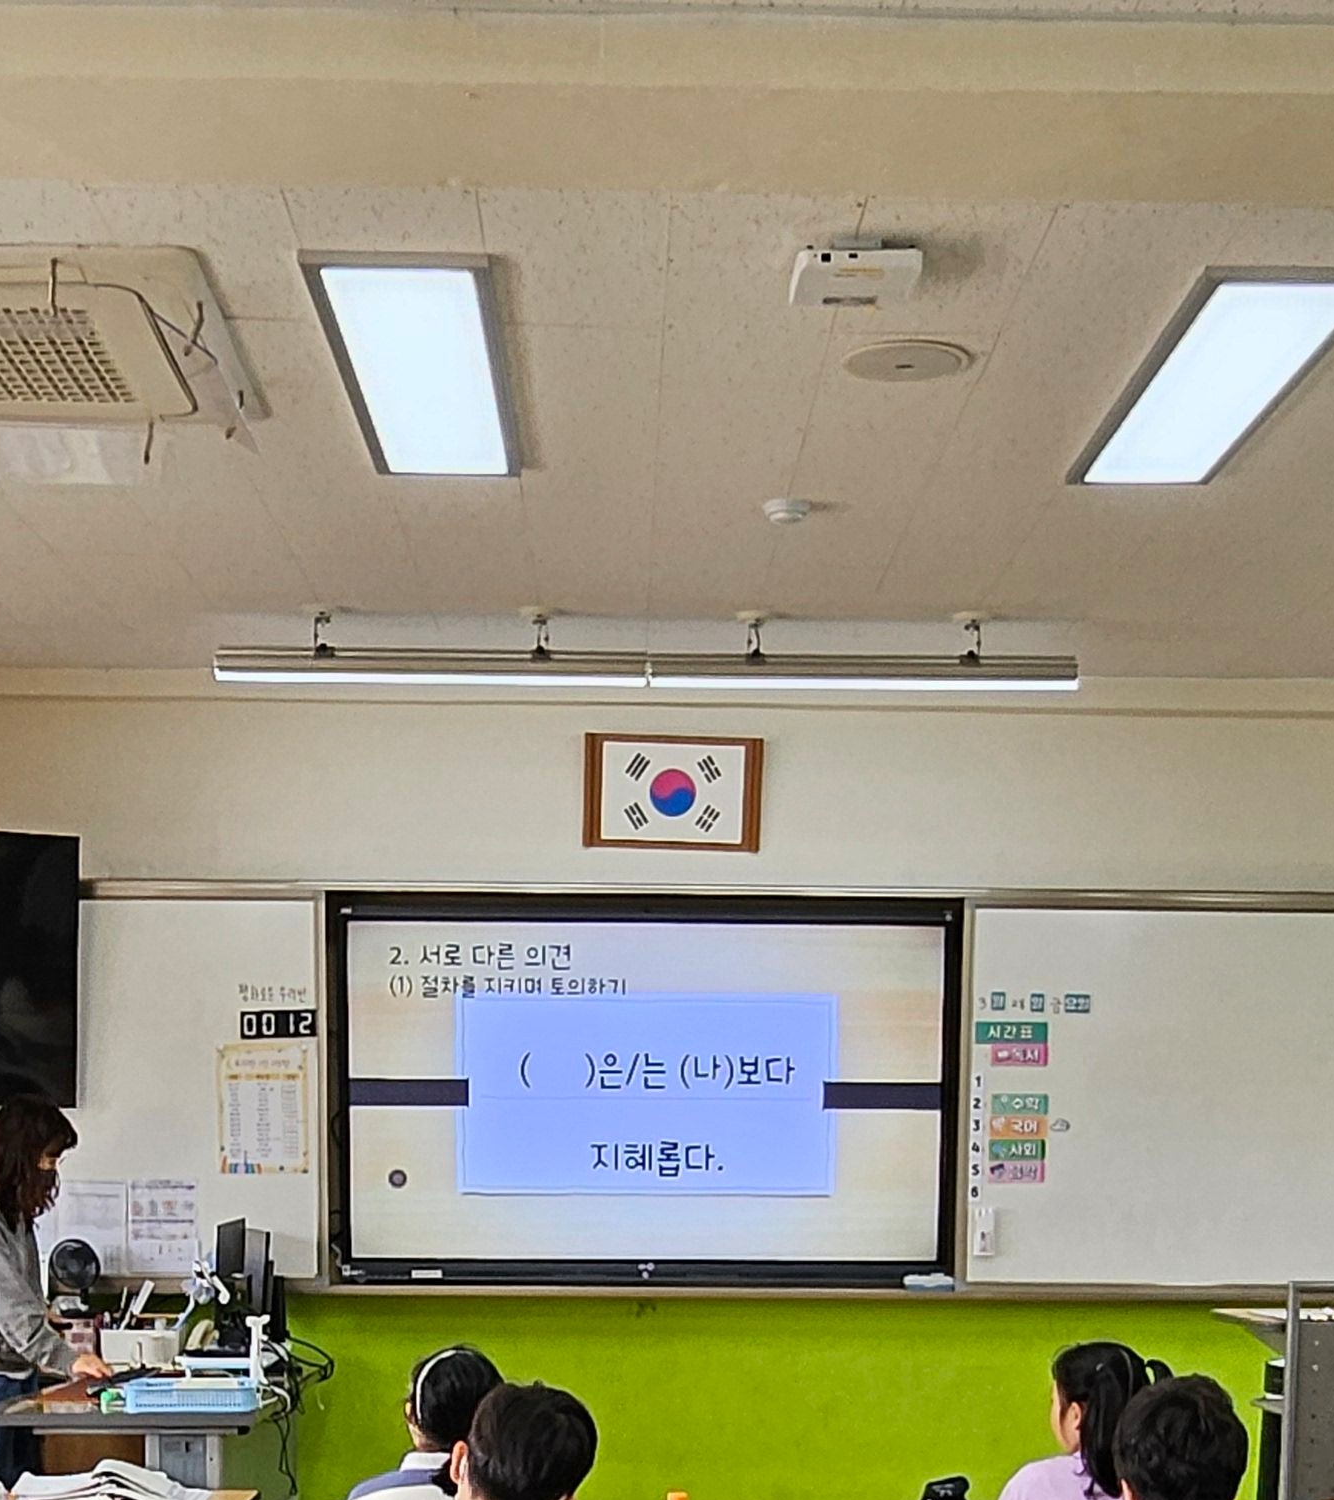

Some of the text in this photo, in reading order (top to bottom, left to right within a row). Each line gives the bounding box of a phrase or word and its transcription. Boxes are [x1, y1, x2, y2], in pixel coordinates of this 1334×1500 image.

[389, 942, 572, 971] 2. 서로 다른 의견
[388, 975, 627, 999] (1) 절차를 지키며 토의하기
[986, 1024, 1034, 1040] 시간표
[679, 1052, 796, 1091] (나)보다
[974, 1074, 983, 1089] 1
[972, 1096, 983, 1111] 2
[1010, 1097, 1041, 1112] 수학
[971, 1118, 982, 1133] 3
[1010, 1121, 1039, 1135] 국어
[970, 1141, 982, 1155] 4
[1008, 1142, 1038, 1158] 사회
[589, 1140, 725, 1178] 지혜롭다.
[970, 1163, 981, 1178] 5
[969, 1185, 980, 1199] 6
